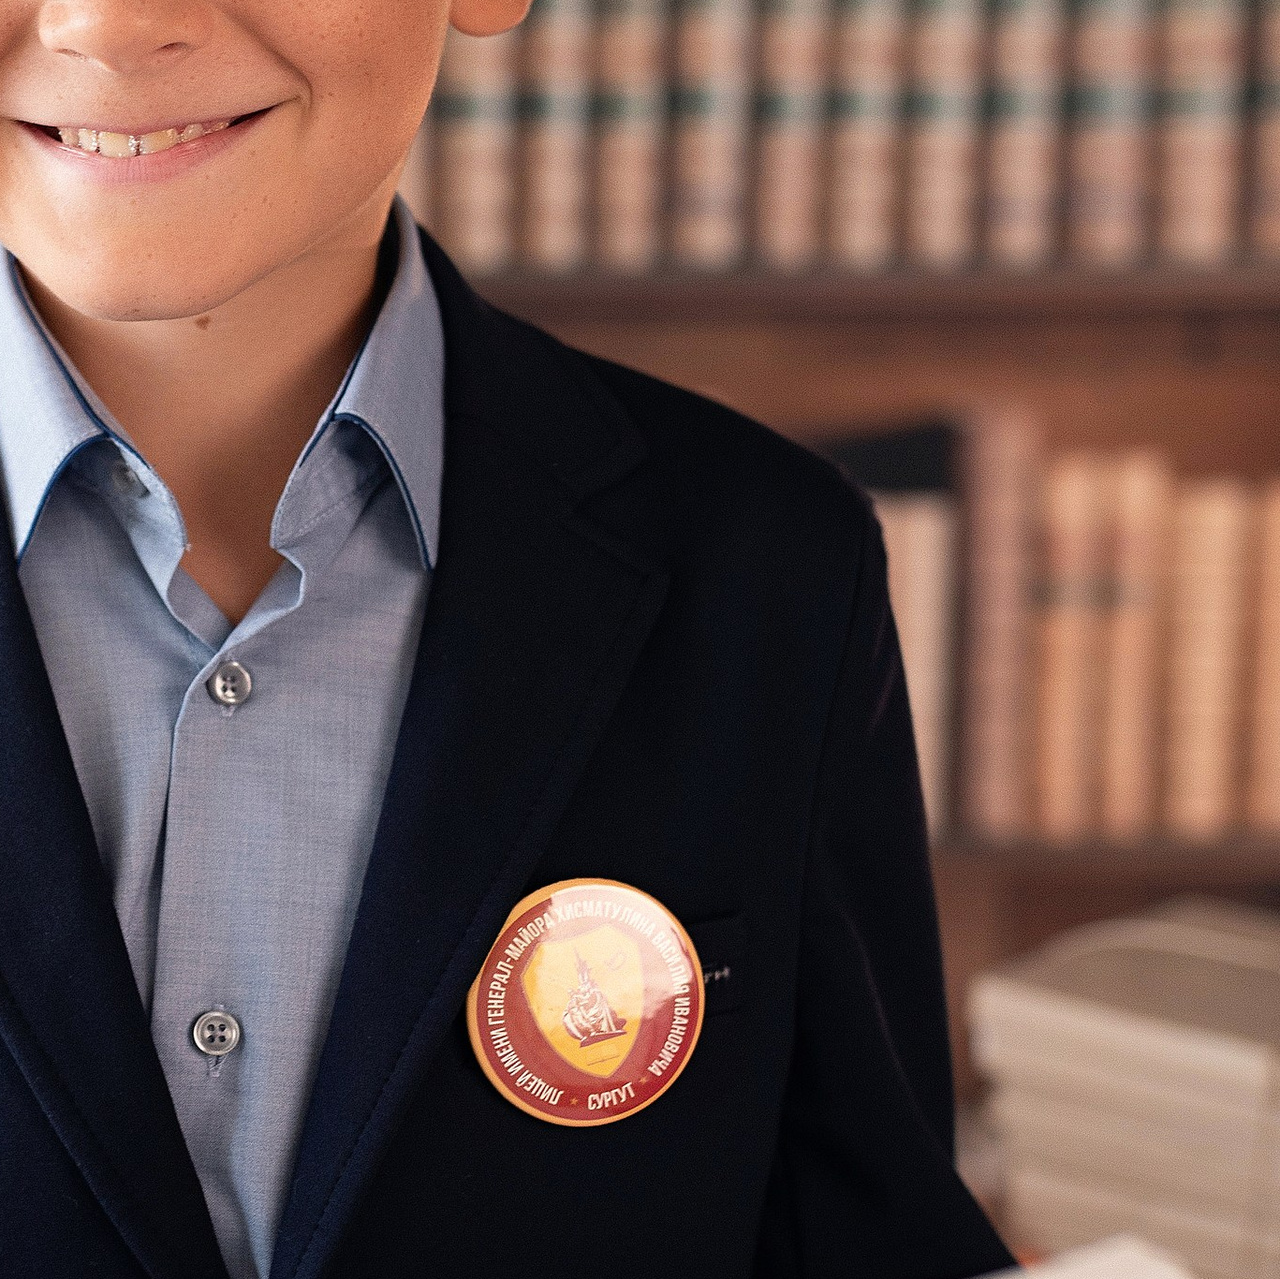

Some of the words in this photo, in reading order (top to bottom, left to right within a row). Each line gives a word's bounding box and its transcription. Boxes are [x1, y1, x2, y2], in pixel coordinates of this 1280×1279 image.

[554, 900, 657, 939] ХИСМАТУЛИНА
[488, 912, 555, 1026] ГЕНЕРАЛ-МАЙОРА
[652, 931, 691, 996] ВАСИЛИЯ
[489, 1027, 525, 1077] ИМЕНИ
[647, 996, 691, 1077] ИВАНОВИЧА
[515, 1069, 564, 1106] ЛИЦЕЙ
[587, 1082, 636, 1110] СУРГУТ
